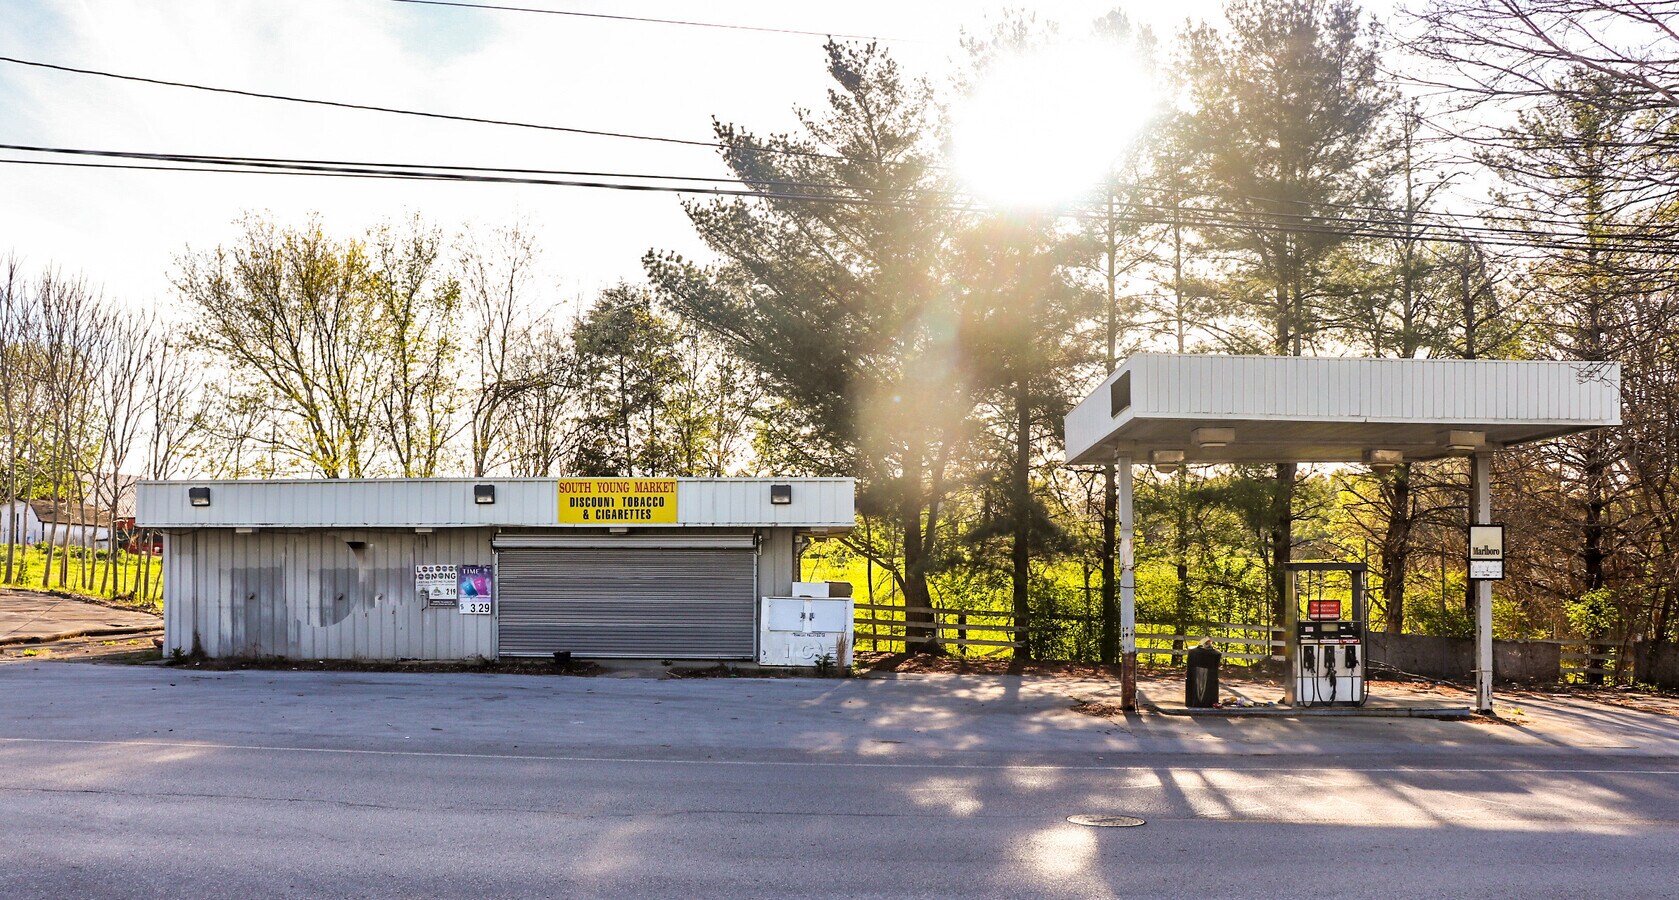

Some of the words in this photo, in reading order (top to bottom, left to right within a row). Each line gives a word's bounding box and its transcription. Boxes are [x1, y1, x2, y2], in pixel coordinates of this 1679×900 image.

[559, 481, 592, 494] SOUTH
[597, 481, 630, 494] YOUNG
[634, 481, 676, 494] MARKET
[622, 496, 665, 508] TOBACCO
[582, 509, 590, 520] &
[595, 509, 652, 520] CIGARETTES
[1472, 544, 1500, 556] Marlboro
[470, 603, 490, 613] 3.29
